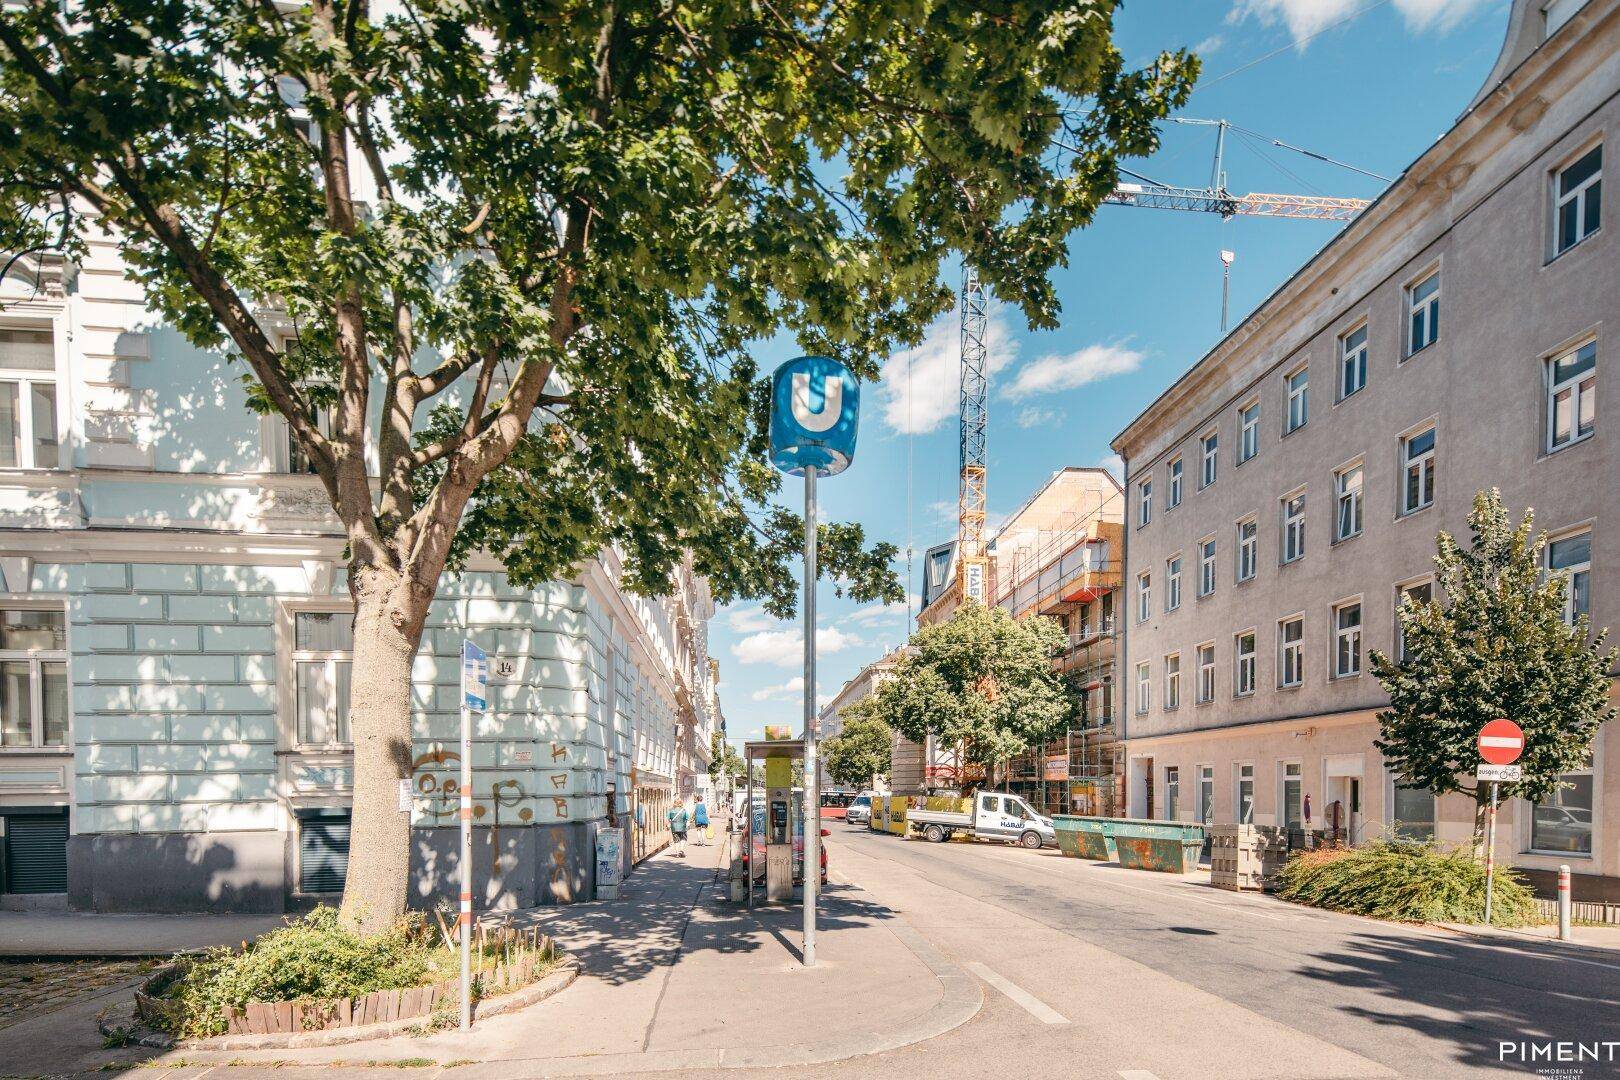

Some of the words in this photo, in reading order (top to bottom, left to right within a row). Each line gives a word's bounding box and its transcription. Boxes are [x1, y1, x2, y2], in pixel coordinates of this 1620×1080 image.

[791, 373, 843, 433] U
[970, 567, 980, 596] HAB
[500, 662, 511, 673] 14
[1000, 821, 1025, 829] HABAU
